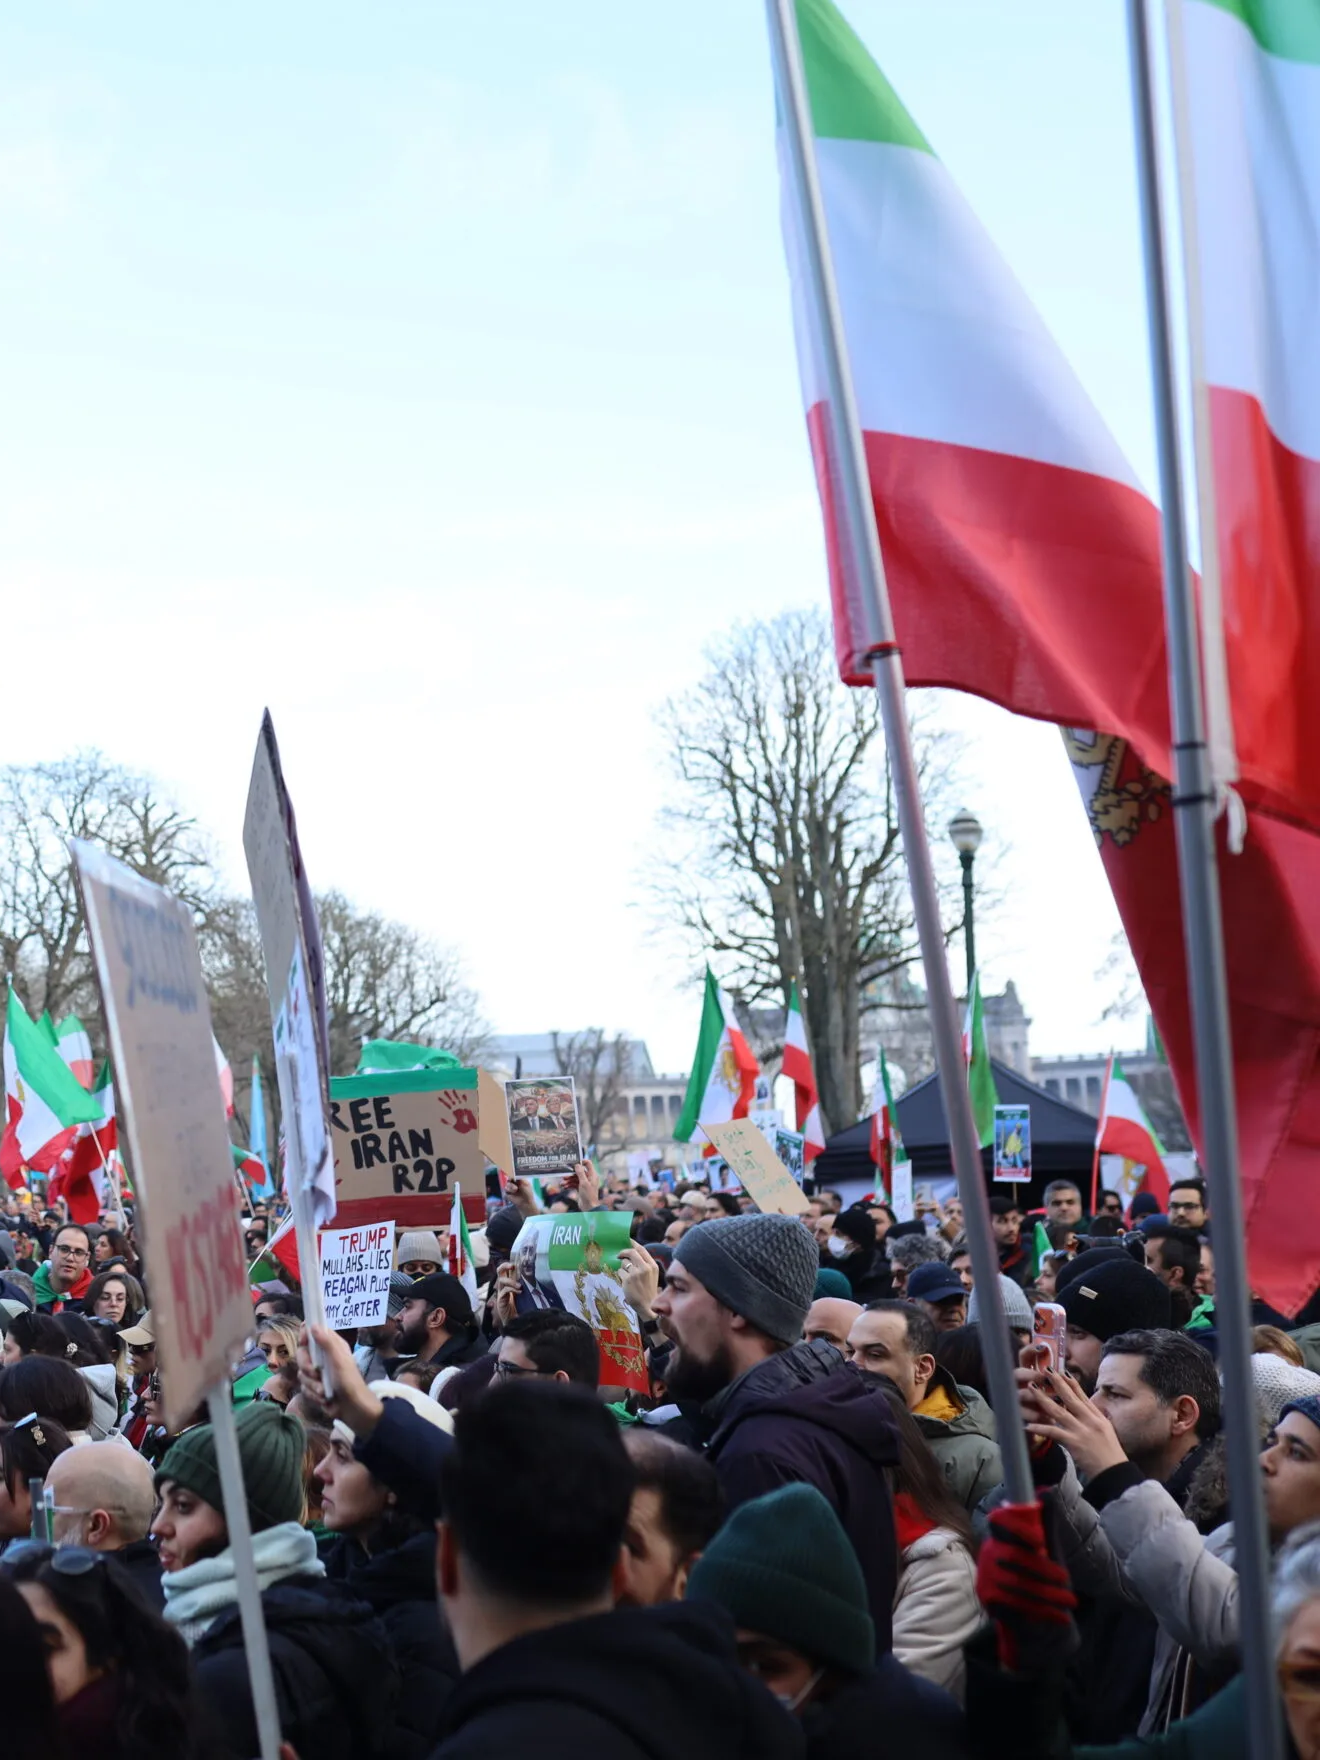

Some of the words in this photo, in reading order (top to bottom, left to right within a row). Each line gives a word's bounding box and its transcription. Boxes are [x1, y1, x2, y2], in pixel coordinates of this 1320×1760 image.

[329, 1096, 395, 1133] REE
[350, 1128, 433, 1169] IRAN
[516, 1154, 547, 1163] FREEDOM
[560, 1153, 576, 1161] IRAN
[392, 1157, 455, 1193] R2P
[339, 1226, 387, 1254] TRUMP
[552, 1225, 581, 1245] IRAN
[324, 1274, 367, 1297] REAGAN
[369, 1275, 389, 1293] PLUS
[342, 1299, 380, 1317] CARTER
[334, 1317, 352, 1327] MINUS
